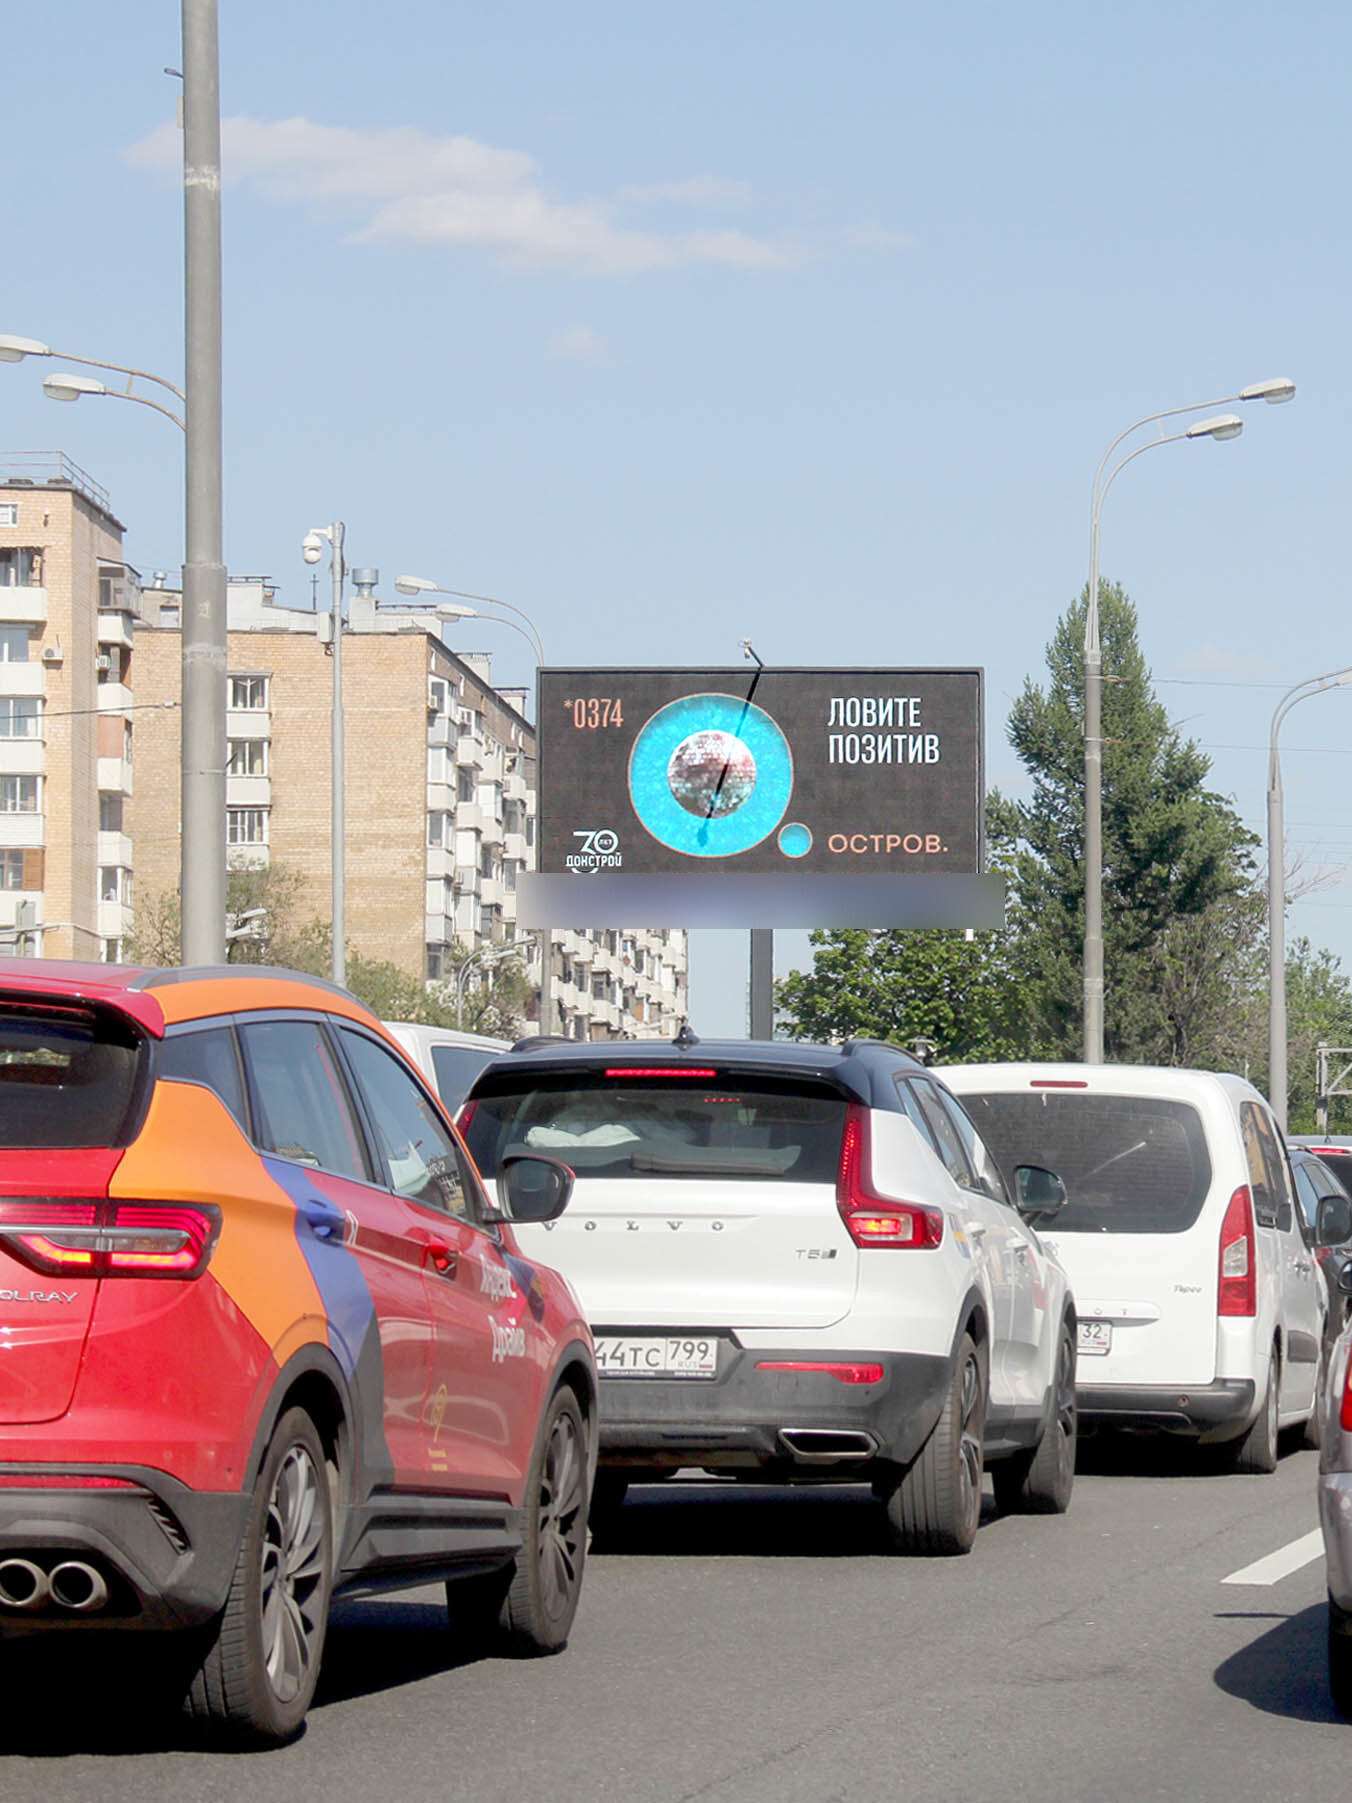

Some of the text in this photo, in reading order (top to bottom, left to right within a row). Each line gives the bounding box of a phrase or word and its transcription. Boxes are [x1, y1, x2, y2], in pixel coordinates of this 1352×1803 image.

[827, 697, 922, 727] ЛОВИТЕ
[828, 734, 940, 764] ПОЗИТИВ
[828, 834, 949, 853] ОСТРОВ.
[565, 851, 623, 867] ДОНСТРОЙ
[542, 1220, 724, 1232] VOLVO
[1082, 1323, 1102, 1339] 32
[669, 1340, 709, 1361] 799
